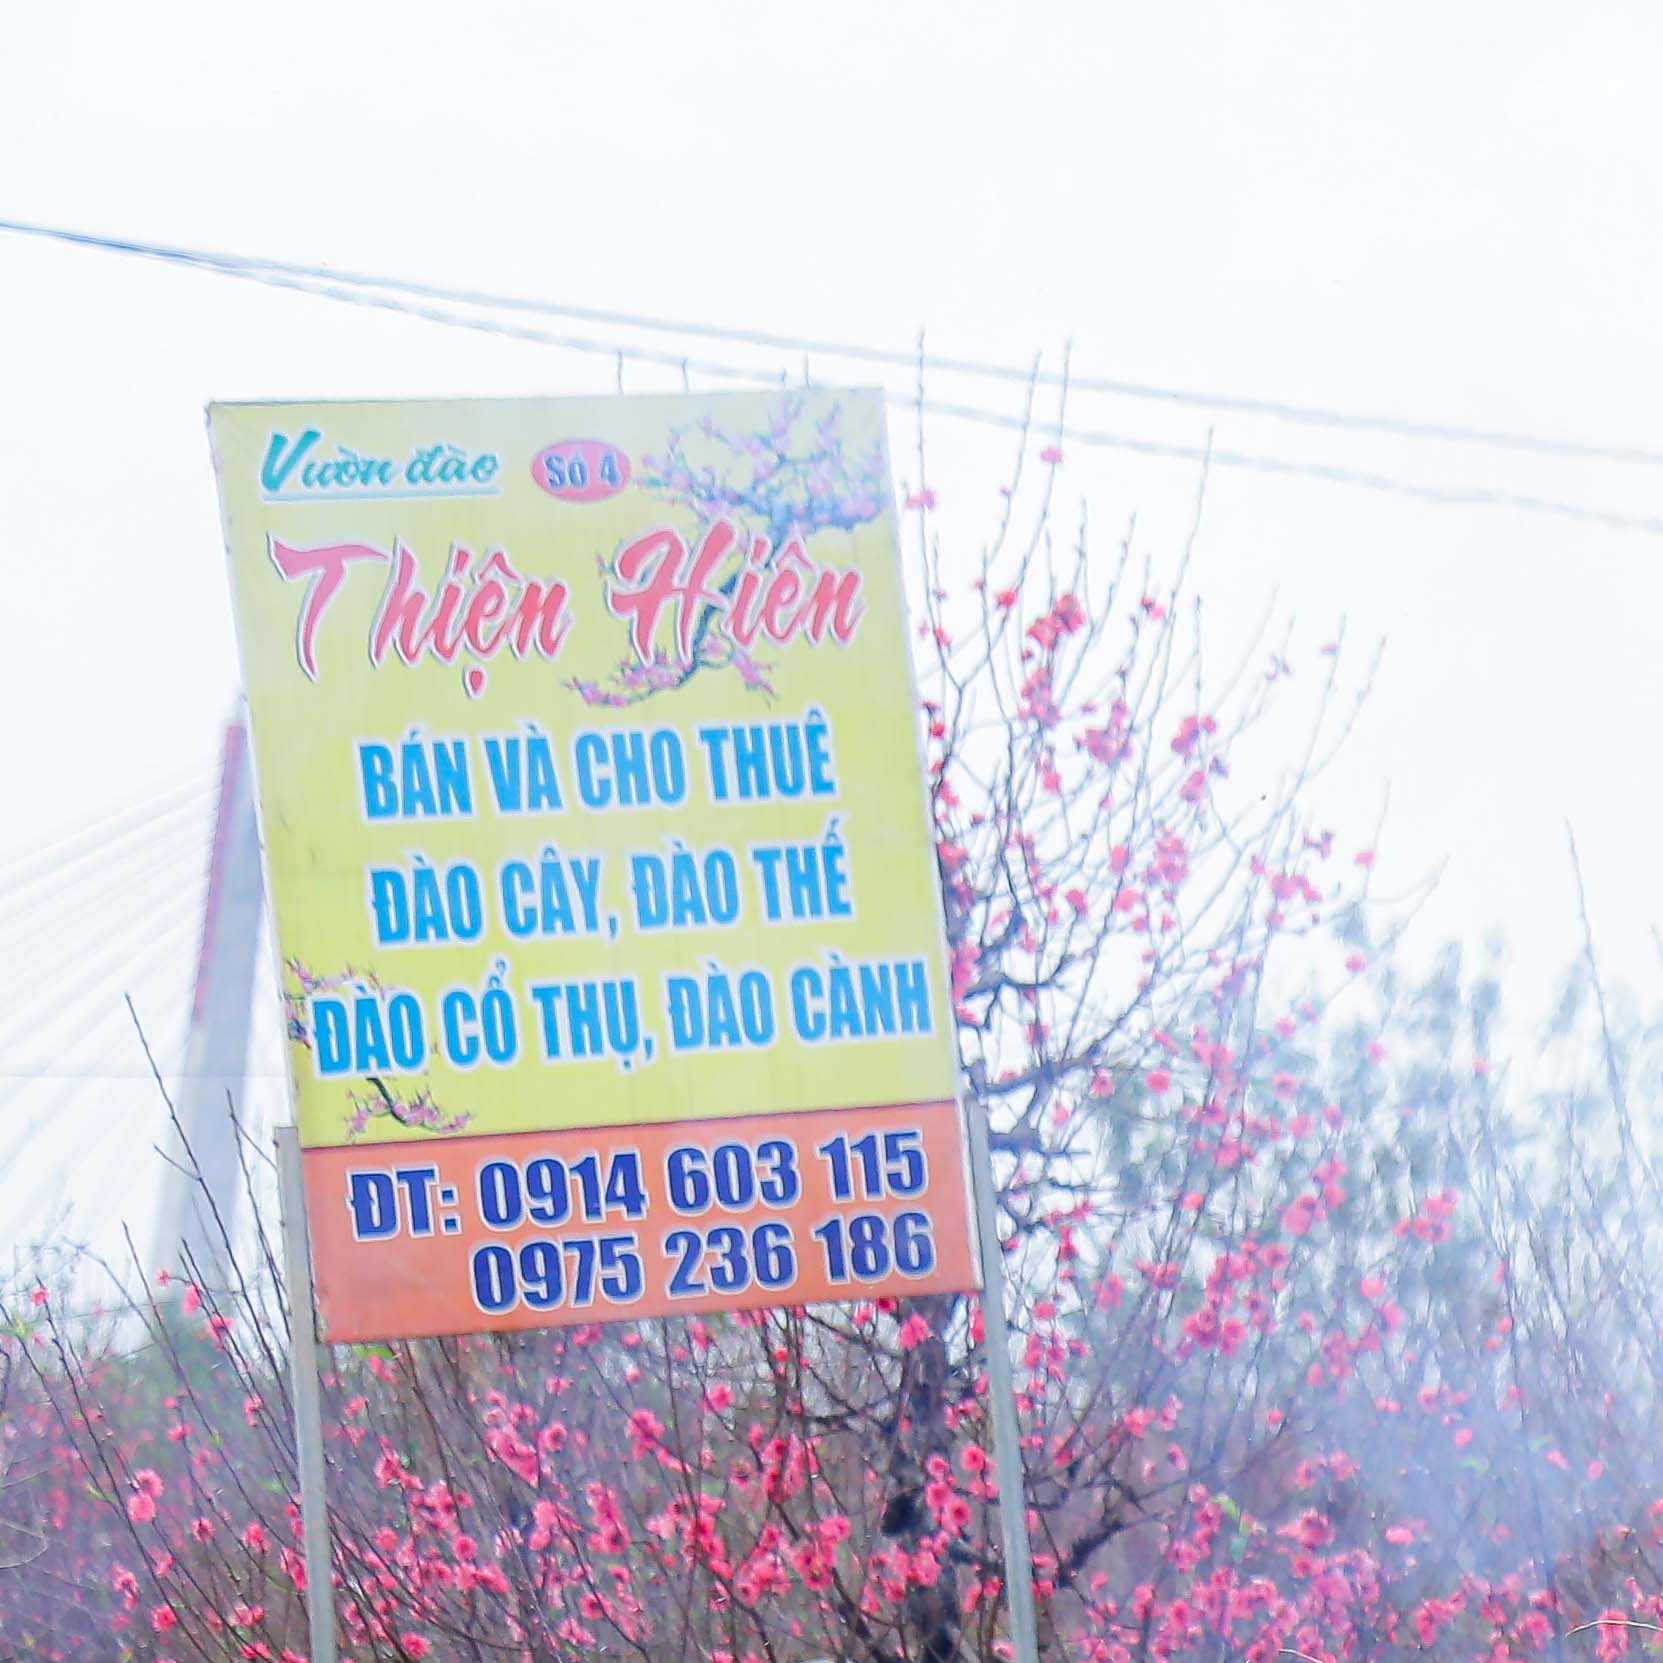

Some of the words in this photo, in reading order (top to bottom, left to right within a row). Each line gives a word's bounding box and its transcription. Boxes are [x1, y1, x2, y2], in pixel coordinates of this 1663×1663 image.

[406, 444, 498, 484] đào
[545, 448, 586, 489] Số
[272, 541, 573, 694] Thiện
[611, 520, 865, 662] Hiên
[359, 729, 473, 819] BÁN
[484, 723, 564, 812] VÀ
[575, 729, 686, 808] CHO
[700, 709, 836, 800] THUÊ
[371, 854, 484, 945] ĐÀO
[501, 846, 618, 938] CÂY,
[633, 840, 738, 930] ĐÀO
[753, 818, 852, 920] THẾ
[312, 984, 425, 1074] ĐÀO
[443, 959, 517, 1067] CỔ
[531, 980, 653, 1070] THỤ,
[667, 960, 775, 1048] ĐÀO
[791, 952, 931, 1041] CÀNH
[350, 1168, 458, 1239] ĐT:
[479, 1152, 647, 1229] 0914
[667, 1140, 799, 1213] 603
[819, 1131, 926, 1201] 115
[473, 1235, 642, 1312] 0975
[664, 1223, 794, 1296] 236
[814, 1211, 936, 1284] 186
